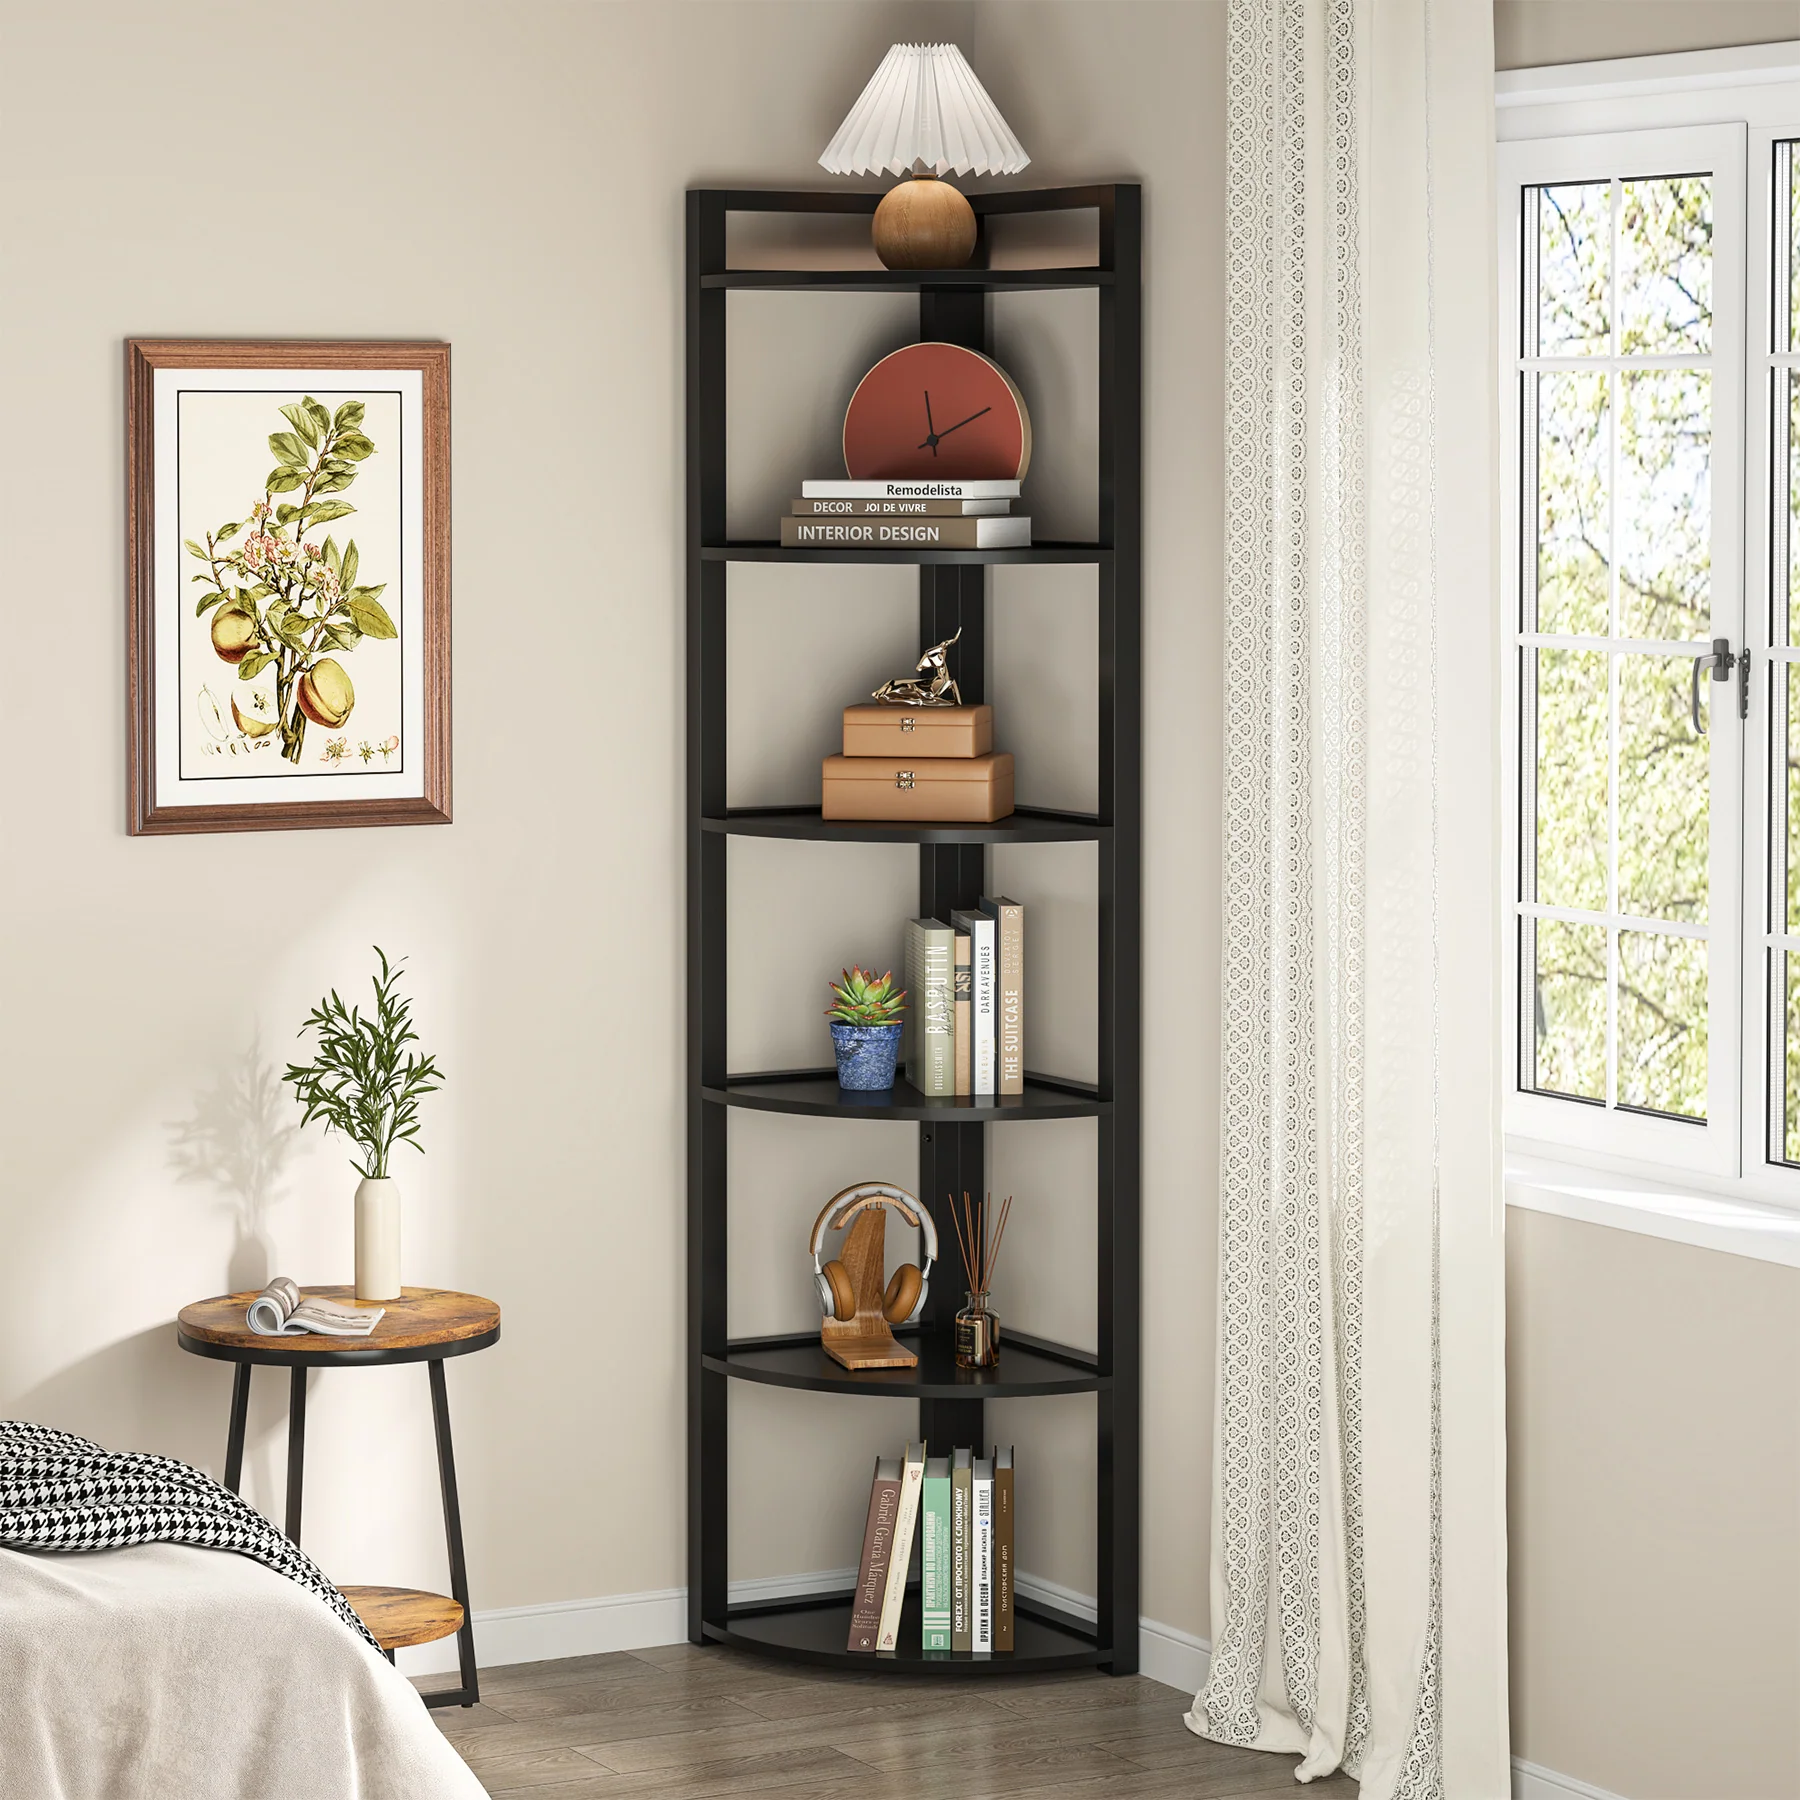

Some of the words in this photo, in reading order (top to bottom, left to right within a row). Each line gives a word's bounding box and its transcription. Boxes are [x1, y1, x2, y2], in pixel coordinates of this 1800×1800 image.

[886, 484, 962, 496] Remodelista
[813, 502, 853, 513] DECOR
[864, 503, 880, 513] JOI
[883, 503, 896, 513] DE
[898, 503, 927, 513] VIVRE
[798, 525, 874, 541] INTERIOR
[879, 526, 940, 541] DESIGN
[980, 946, 990, 988] AVENUES
[1011, 929, 1019, 974] SERGEY
[925, 946, 948, 1034] RASPUTIN
[980, 989, 990, 1013] DARK
[1004, 990, 1019, 1052] SUITCASE
[1004, 1057, 1019, 1081] THE
[877, 1489, 896, 1525] Gabriel
[955, 1487, 963, 1537] СЛОЖНОМУ
[871, 1527, 890, 1559] García
[955, 1545, 963, 1586] ПРОСТОГО
[861, 1562, 885, 1604] Márquez
[955, 1587, 963, 1599] ОТ
[955, 1601, 963, 1633] FOREX:
